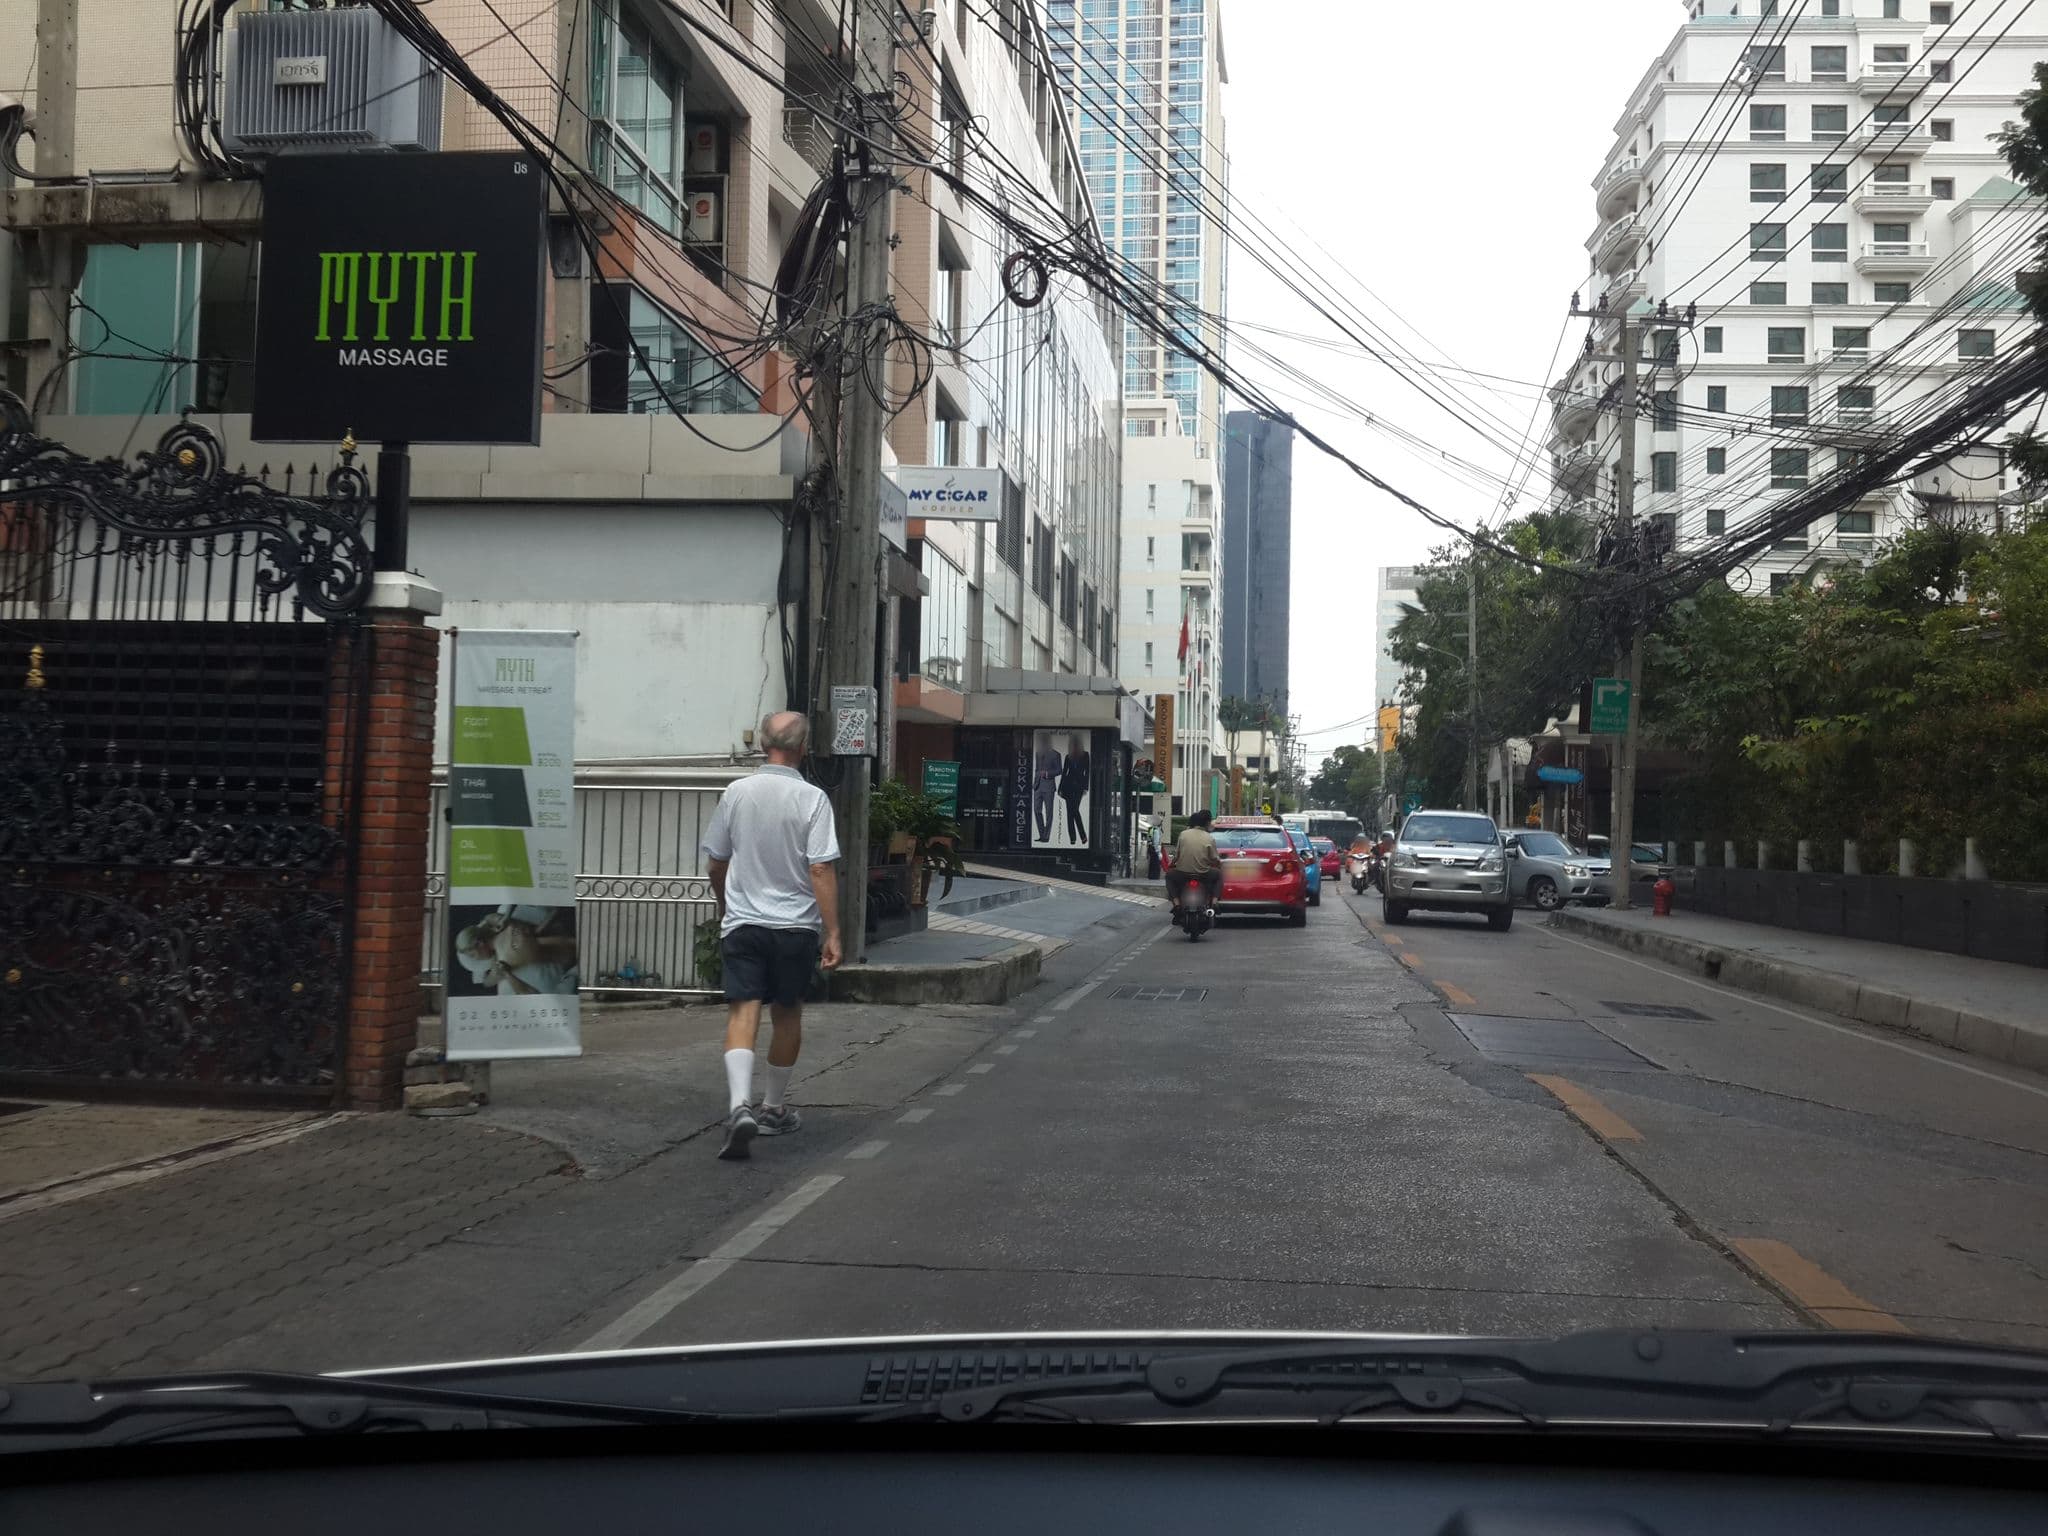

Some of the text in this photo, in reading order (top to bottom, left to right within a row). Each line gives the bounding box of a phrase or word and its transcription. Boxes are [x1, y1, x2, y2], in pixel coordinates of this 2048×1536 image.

[315, 251, 477, 341] MYTH
[338, 348, 449, 367] MASSAGE
[908, 489, 989, 502] MY CIGAR
[495, 657, 535, 682] MYTH
[1158, 749, 1168, 783] ONRAD
[462, 779, 487, 788] THAI
[1016, 799, 1027, 843] ANGEL
